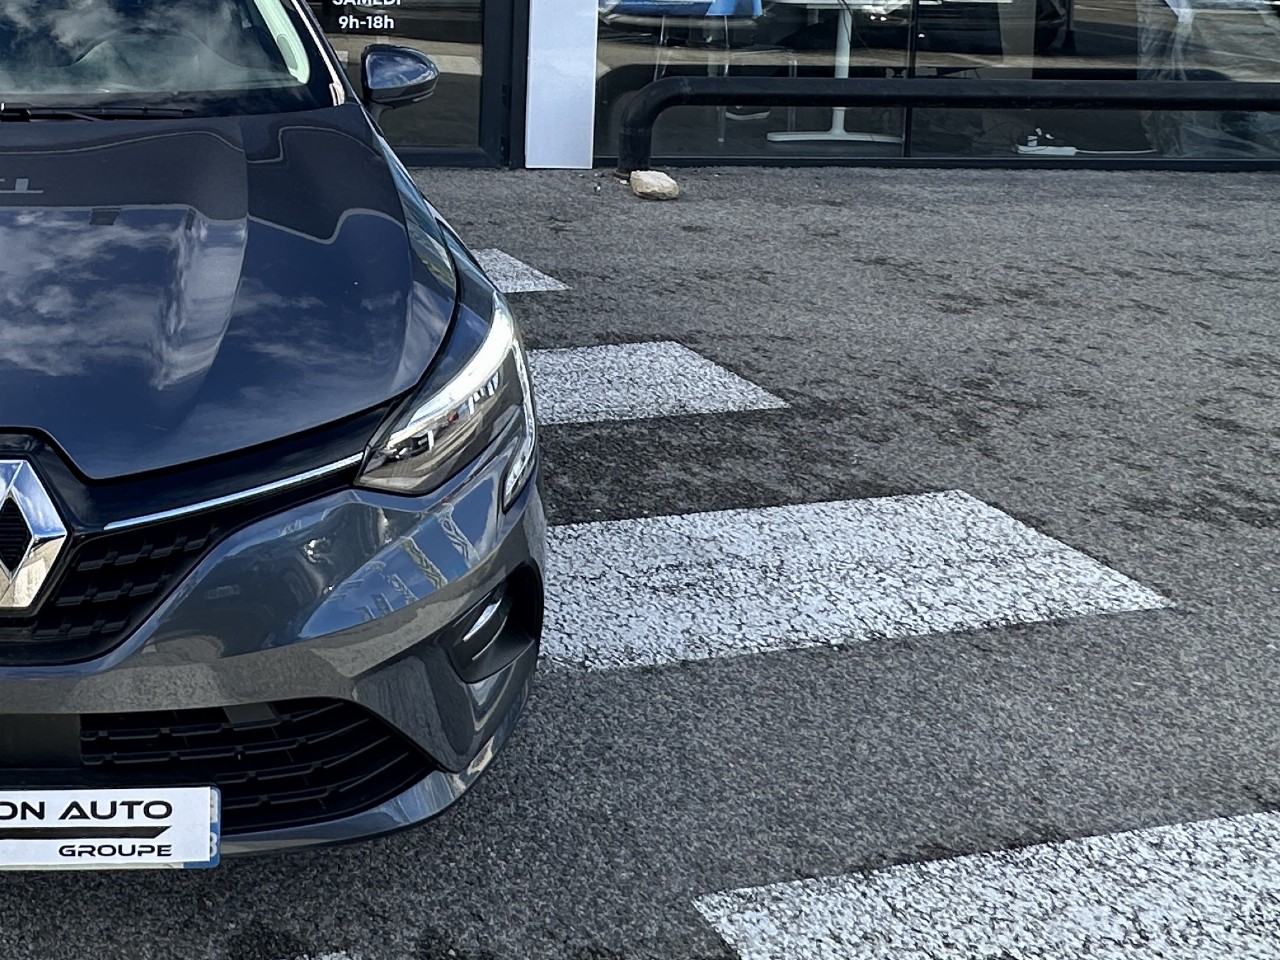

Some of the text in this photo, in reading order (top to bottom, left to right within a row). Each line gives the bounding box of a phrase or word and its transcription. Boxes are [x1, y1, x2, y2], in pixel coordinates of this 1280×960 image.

[338, 15, 395, 29] 9h-18h
[58, 799, 173, 820] AUTO
[58, 843, 173, 858] GROUPE
